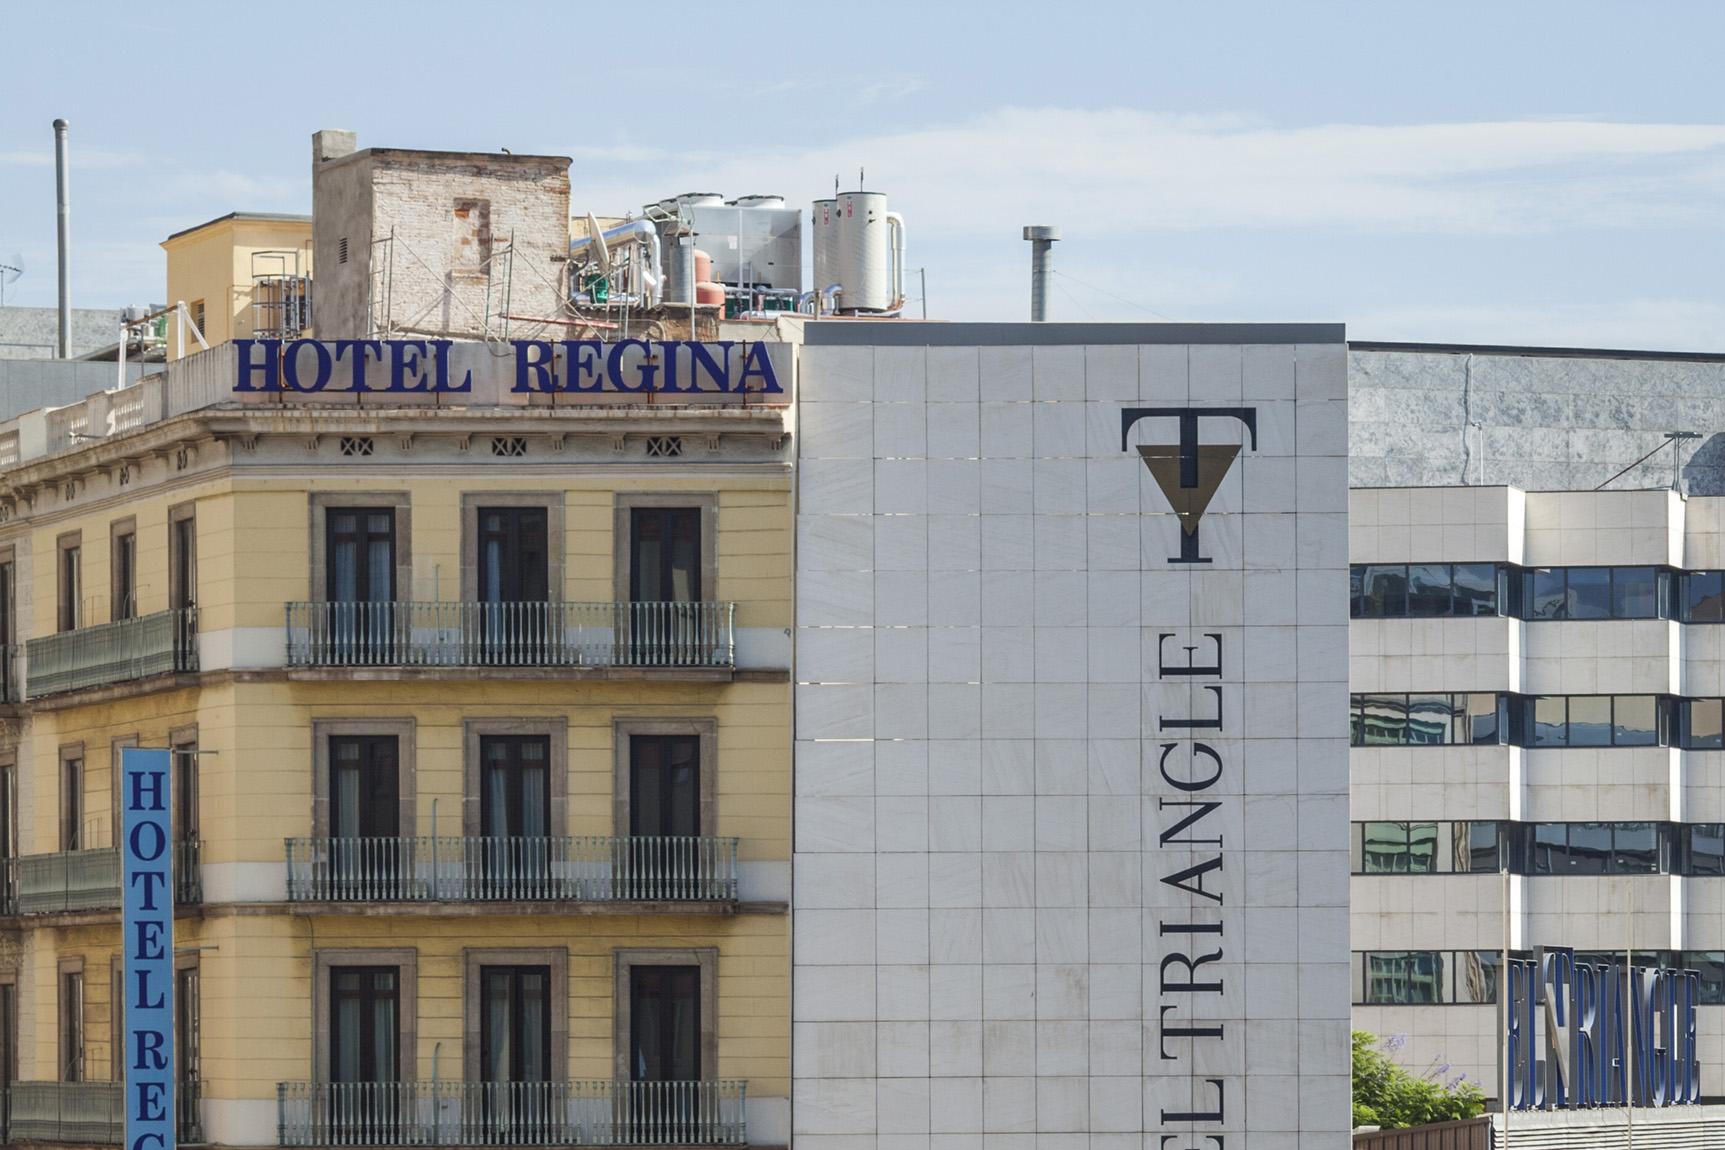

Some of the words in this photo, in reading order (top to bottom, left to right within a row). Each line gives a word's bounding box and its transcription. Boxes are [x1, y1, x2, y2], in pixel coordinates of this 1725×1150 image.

[232, 338, 471, 393] HOTEL
[511, 339, 783, 394] REGINA
[128, 770, 166, 1010] HOTEL
[1159, 632, 1225, 1060] TRIANGLE
